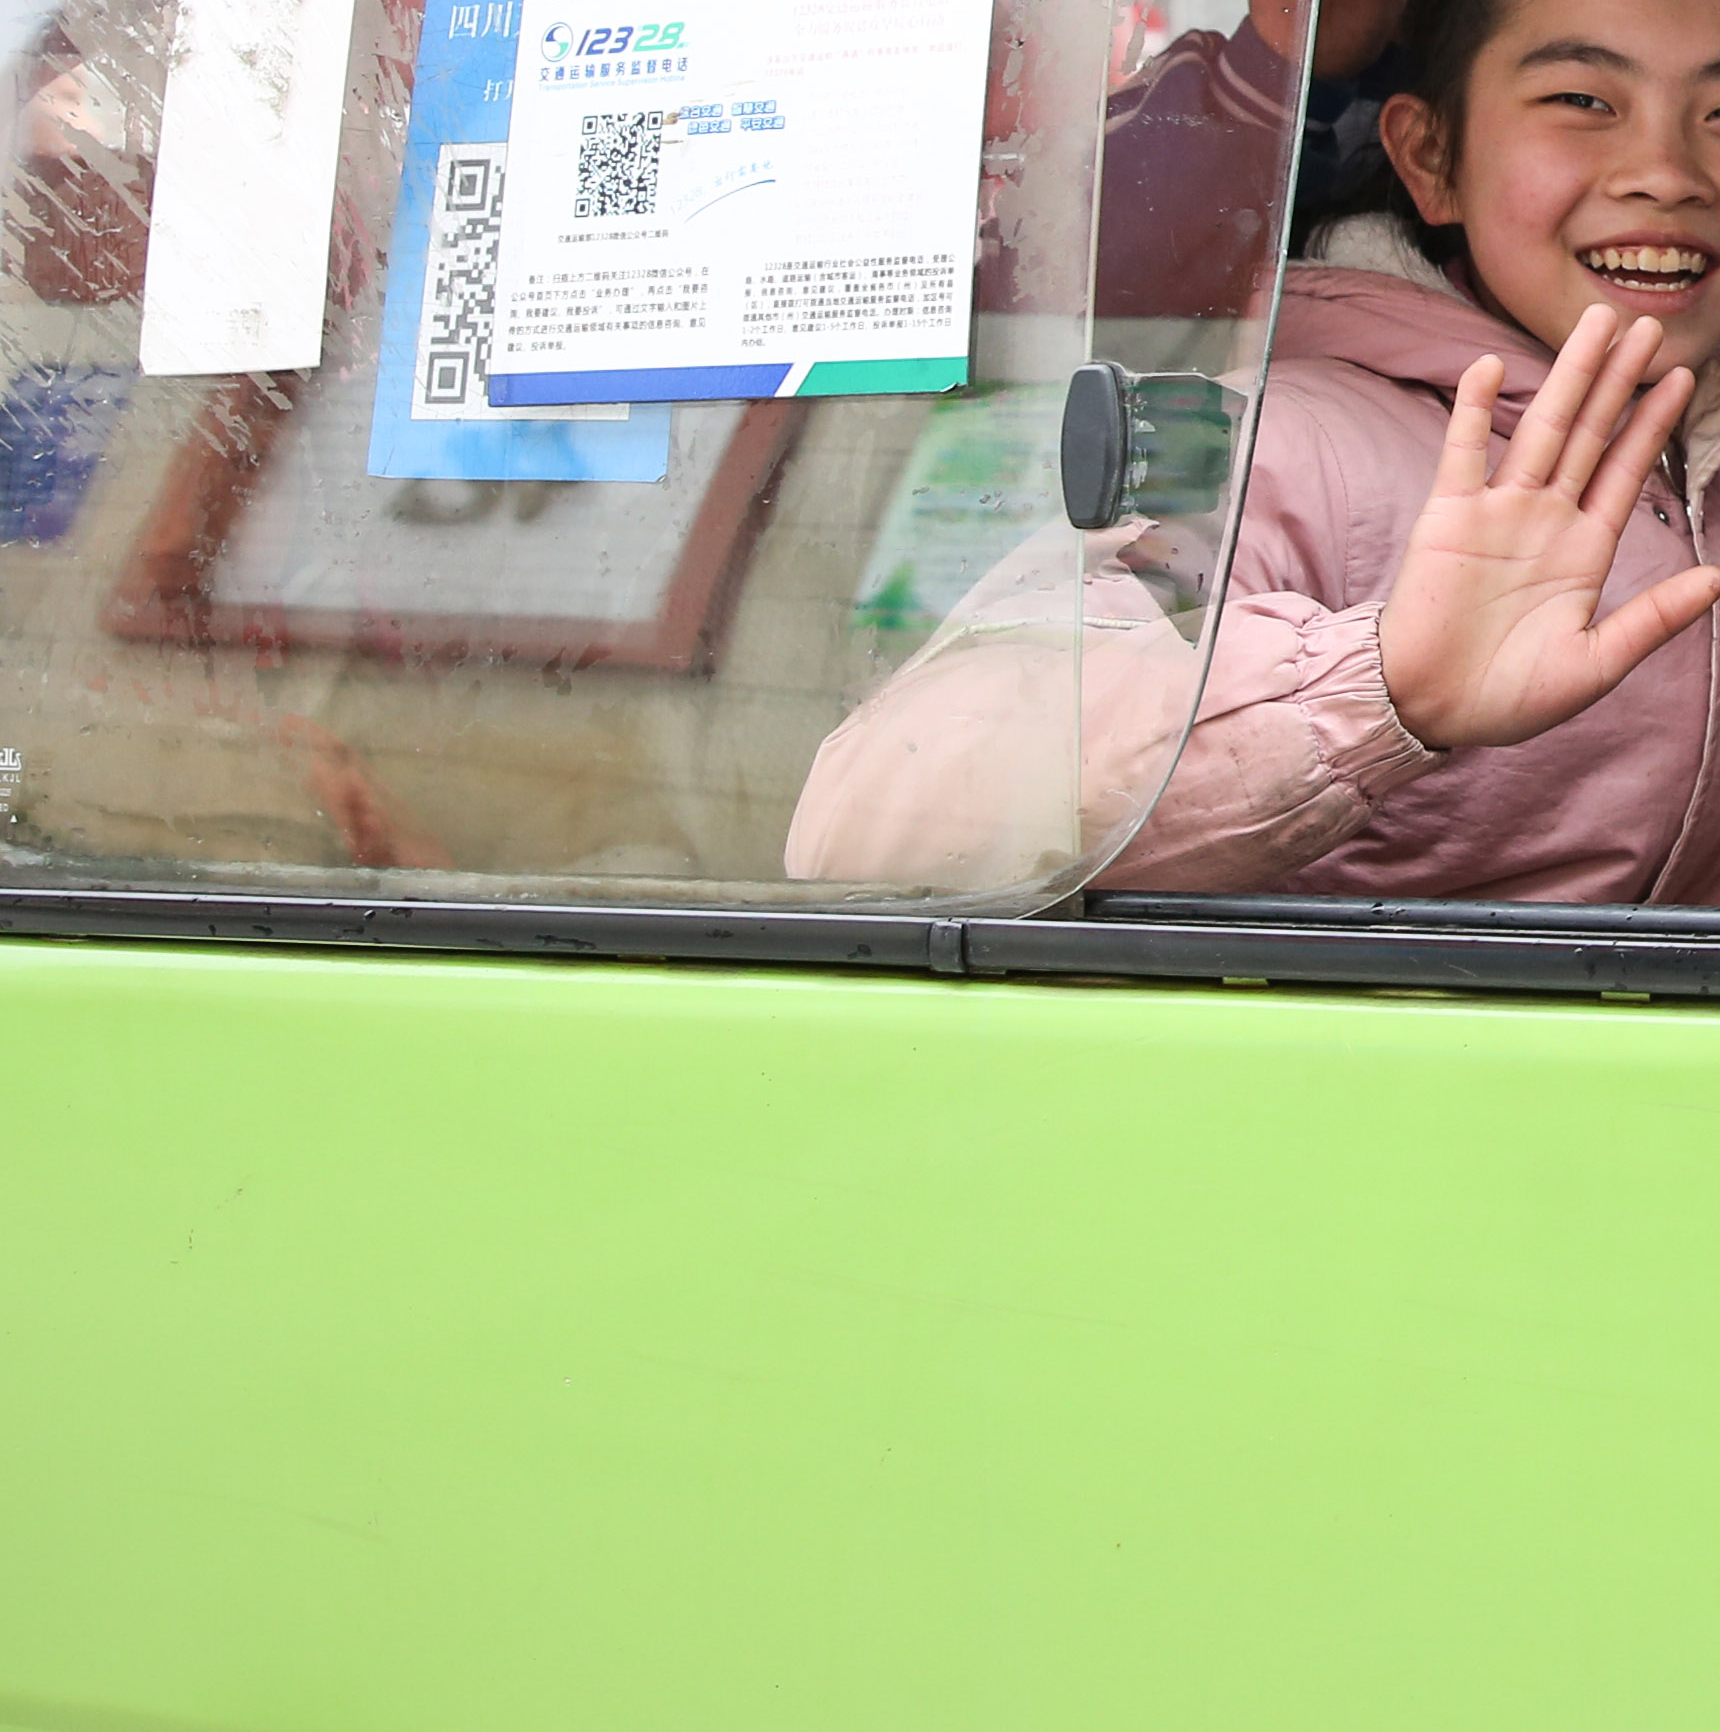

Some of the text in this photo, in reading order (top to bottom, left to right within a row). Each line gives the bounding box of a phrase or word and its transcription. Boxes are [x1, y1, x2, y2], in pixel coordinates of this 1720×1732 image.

[449, 1, 521, 39] 四川
[575, 21, 686, 56] 12328
[538, 56, 689, 83] 交通运输服务监督电话
